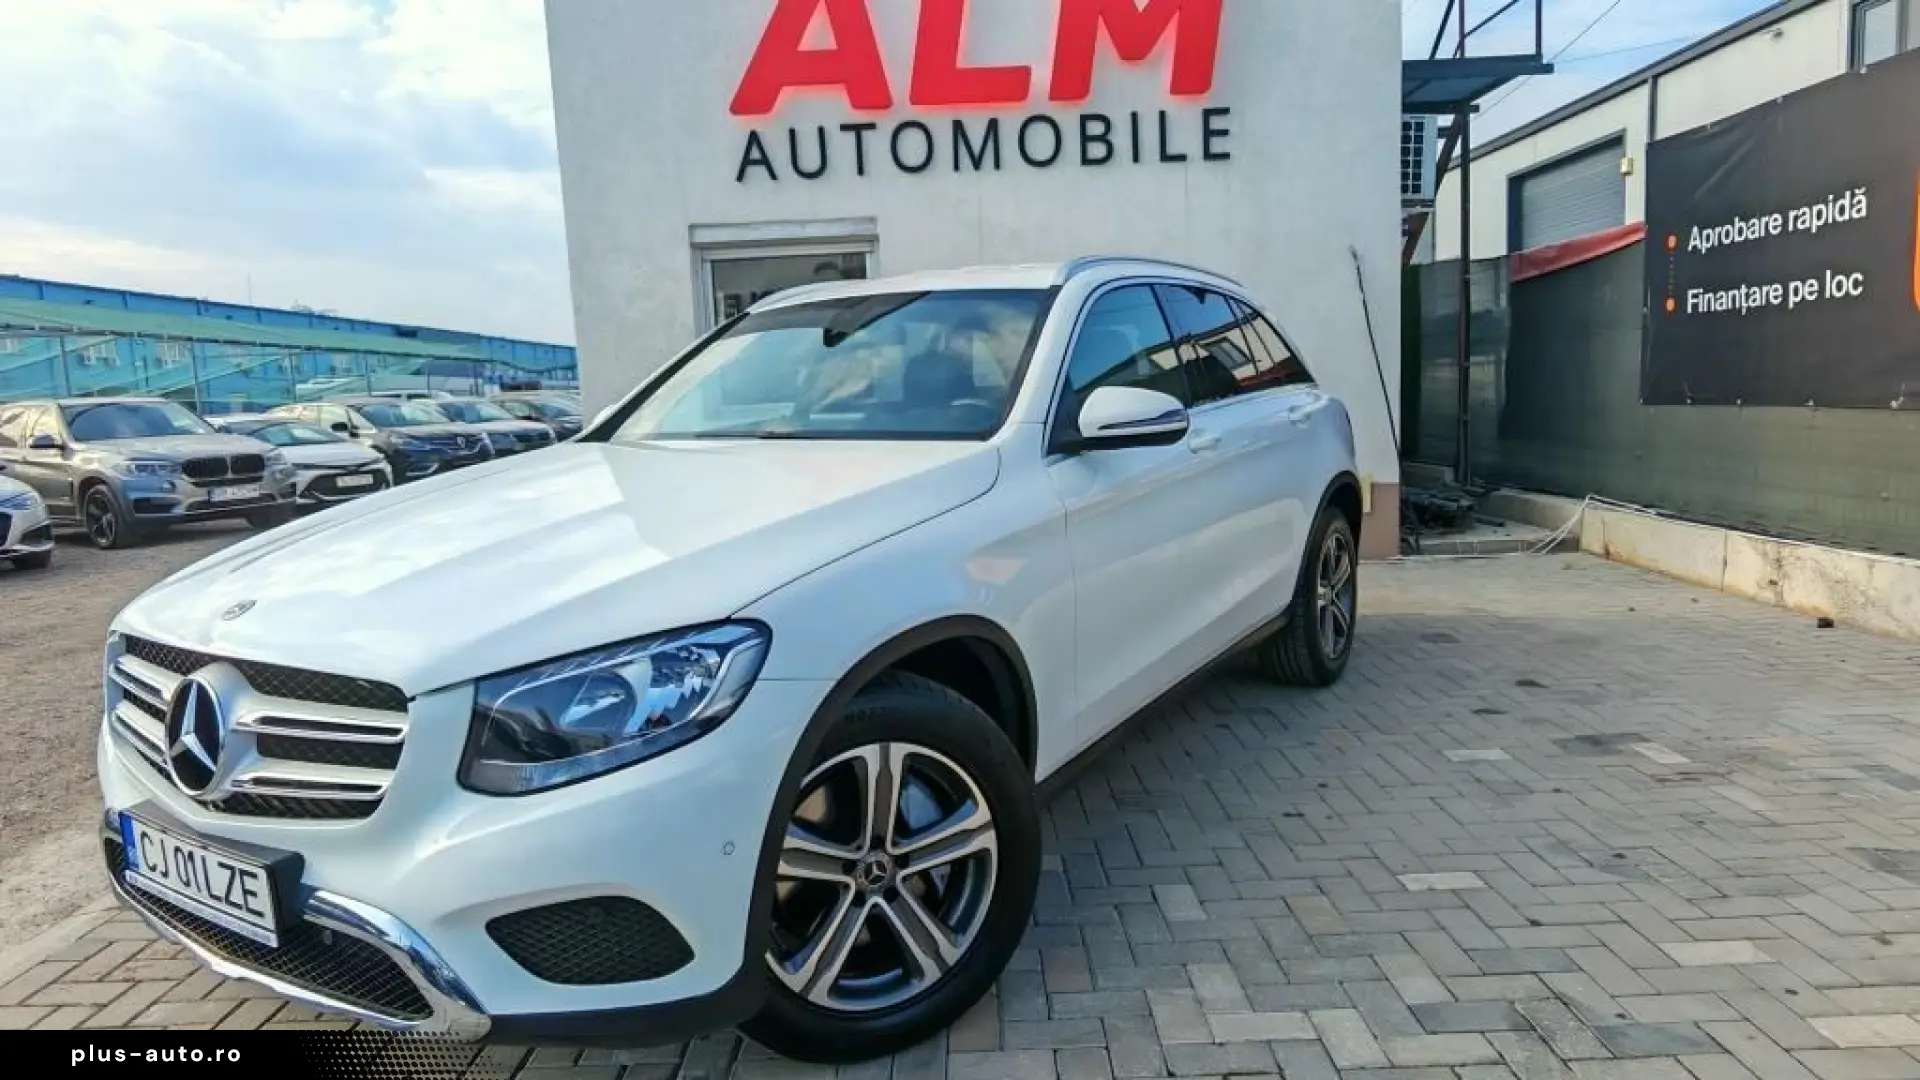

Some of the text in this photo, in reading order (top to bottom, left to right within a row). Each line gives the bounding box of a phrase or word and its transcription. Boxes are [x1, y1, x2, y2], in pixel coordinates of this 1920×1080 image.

[729, 0, 1223, 115] ALM
[736, 107, 1231, 182] AUTOMOBILE
[1687, 187, 1867, 255] Aprobare rapidă
[1686, 269, 1864, 316] Finanțare pe loc
[140, 830, 170, 878] CJ
